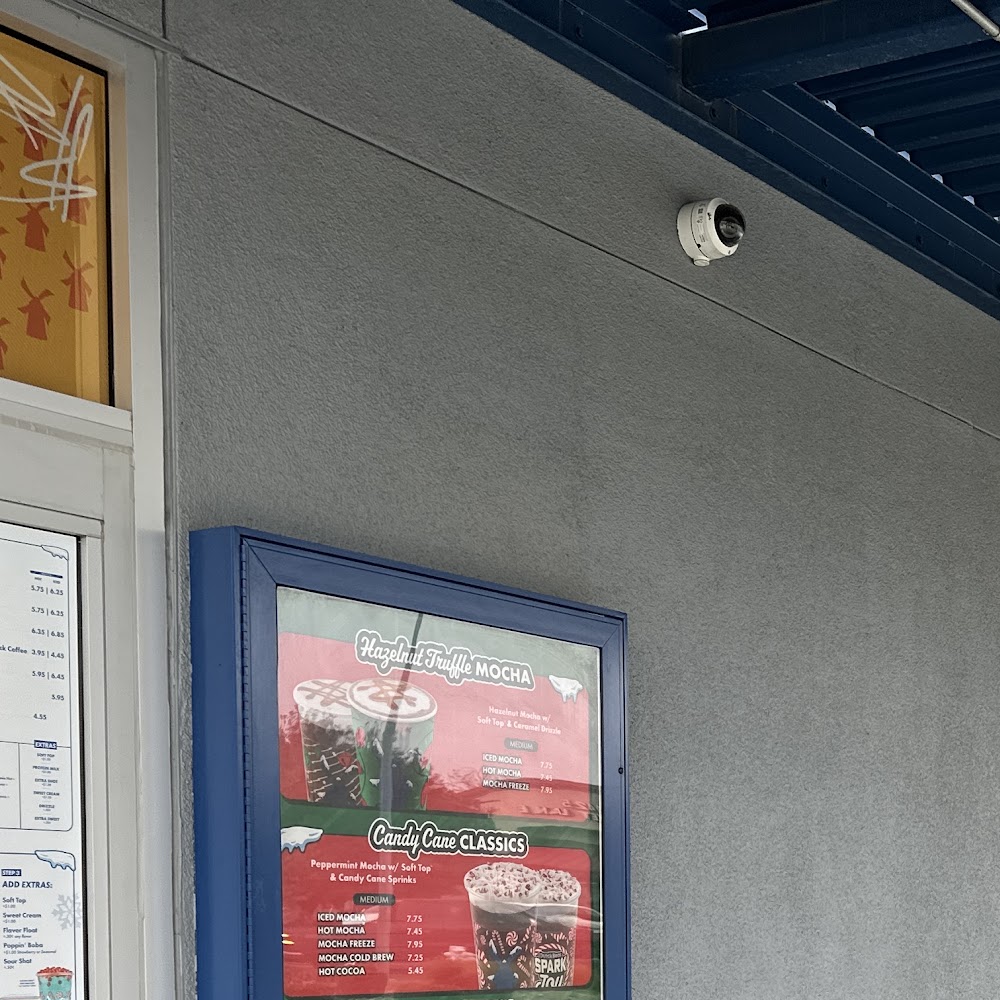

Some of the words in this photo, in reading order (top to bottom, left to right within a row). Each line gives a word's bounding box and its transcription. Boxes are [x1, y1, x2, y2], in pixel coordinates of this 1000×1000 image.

[8, 645, 28, 654] Coffee
[360, 636, 423, 669] Hazelnut
[425, 648, 472, 679] Truffle
[475, 661, 532, 685] MOCHA
[489, 706, 519, 717] Hazelnut
[520, 710, 540, 721] Mocha
[477, 716, 491, 725] Soft
[492, 718, 505, 728] Top
[507, 720, 512, 728] &
[513, 721, 540, 732] Caramel
[541, 725, 561, 735] Drizzle
[510, 741, 534, 750] MEDIUM
[482, 753, 497, 762] ICED
[498, 756, 523, 765] MOCHA
[540, 761, 553, 769] 7.75
[482, 766, 496, 775] HOT
[497, 769, 522, 778] MOCHA
[482, 779, 508, 789] MOCHA
[508, 782, 530, 791] FREEZE
[540, 786, 553, 794] 7.95
[373, 824, 420, 855] Candy
[421, 827, 457, 850] Cane
[459, 833, 525, 853] CLASSICS
[310, 859, 358, 871] Peppermint
[359, 862, 386, 871] Mocha
[388, 862, 400, 872] w/
[401, 863, 417, 872] Soft
[418, 865, 432, 874] Top
[330, 873, 337, 882] &
[338, 873, 365, 885] Candy
[366, 875, 387, 884] Cane
[388, 875, 417, 886] Sprinks
[2, 880, 20, 888] ADD
[22, 881, 53, 889] EXTRAS:
[359, 895, 390, 904] MEDIUM
[317, 913, 335, 922] ICED
[336, 912, 367, 922] MOCHA
[406, 914, 424, 923] 7.75
[317, 926, 335, 935] HOT
[336, 926, 366, 935] MOCHA
[407, 927, 424, 936] 7.45
[318, 939, 350, 949] MOCHA
[350, 939, 376, 948] FREEZE
[407, 940, 424, 949] 7.95
[318, 953, 349, 963] MOCHA
[349, 953, 371, 962] COLD
[372, 953, 395, 962] BREW
[407, 953, 424, 962] 7.25
[534, 957, 567, 974] SPARK
[318, 967, 336, 976] HOT
[336, 967, 366, 976] COCOA
[408, 966, 425, 975] 5.45
